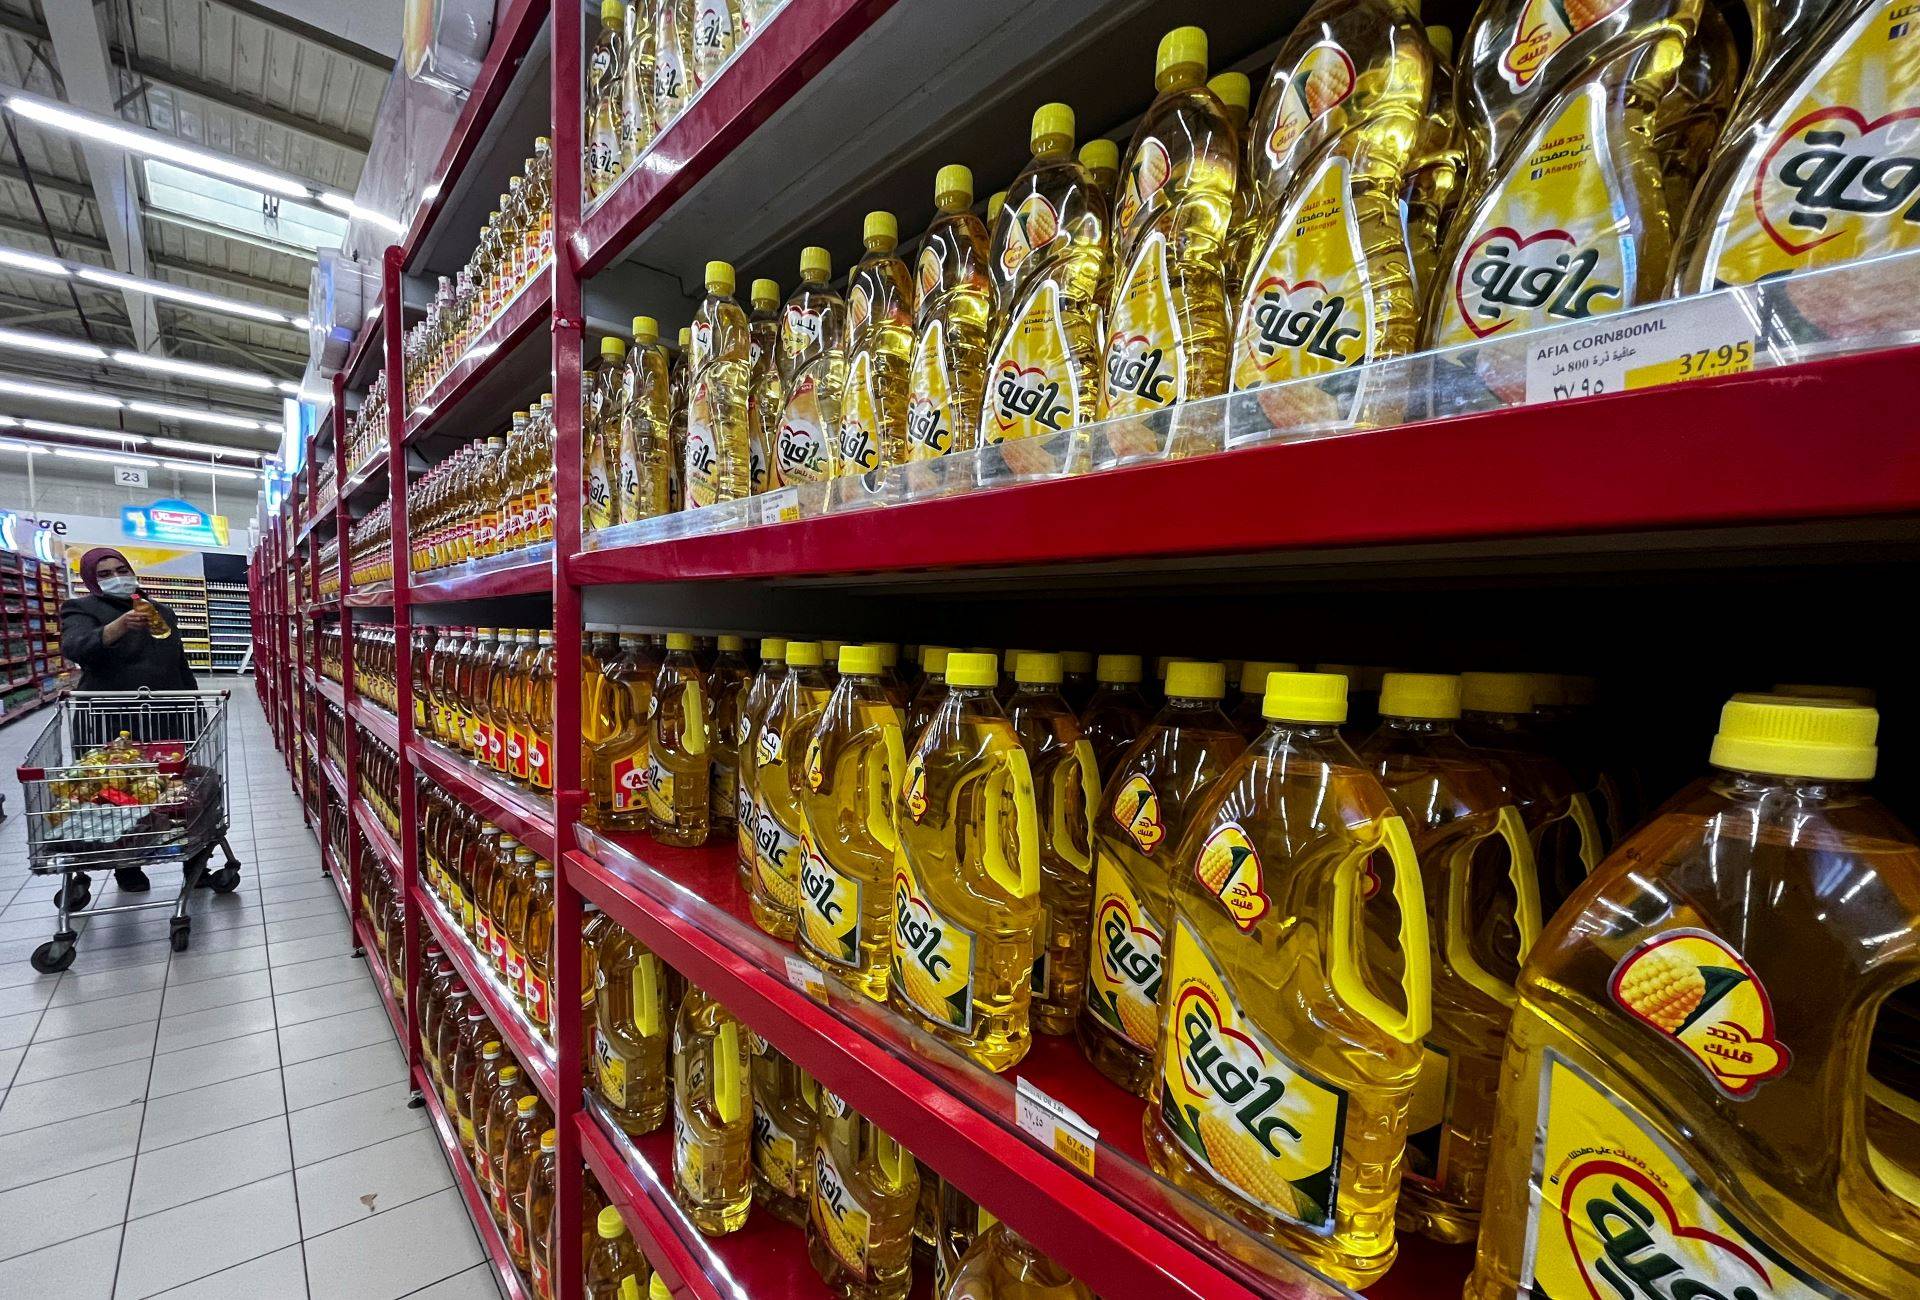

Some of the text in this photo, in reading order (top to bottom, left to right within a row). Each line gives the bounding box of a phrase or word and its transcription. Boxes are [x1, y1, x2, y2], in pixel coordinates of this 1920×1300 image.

[1780, 130, 1920, 233] فية
[1472, 245, 1620, 318] عافية
[1255, 291, 1361, 363] عافية
[1537, 318, 1667, 360] AFIA CORN800ML
[1108, 344, 1174, 403] عافية
[1552, 346, 1637, 377] عافية ذرة 800 مل
[1679, 340, 1749, 375] 37.95
[998, 371, 1070, 431] عافية
[781, 432, 828, 473] عافية
[122, 472, 140, 483] 23
[1231, 898, 1253, 910] قلبك
[1232, 886, 1248, 897] جدد
[896, 882, 952, 983] عافية
[1105, 910, 1162, 1005] فية
[1704, 1044, 1753, 1063] قلبك
[1706, 1026, 1741, 1044] جدد
[1185, 1000, 1303, 1158] عافية
[1066, 1135, 1090, 1157] 67.45
[1595, 1146, 1613, 1155] على
